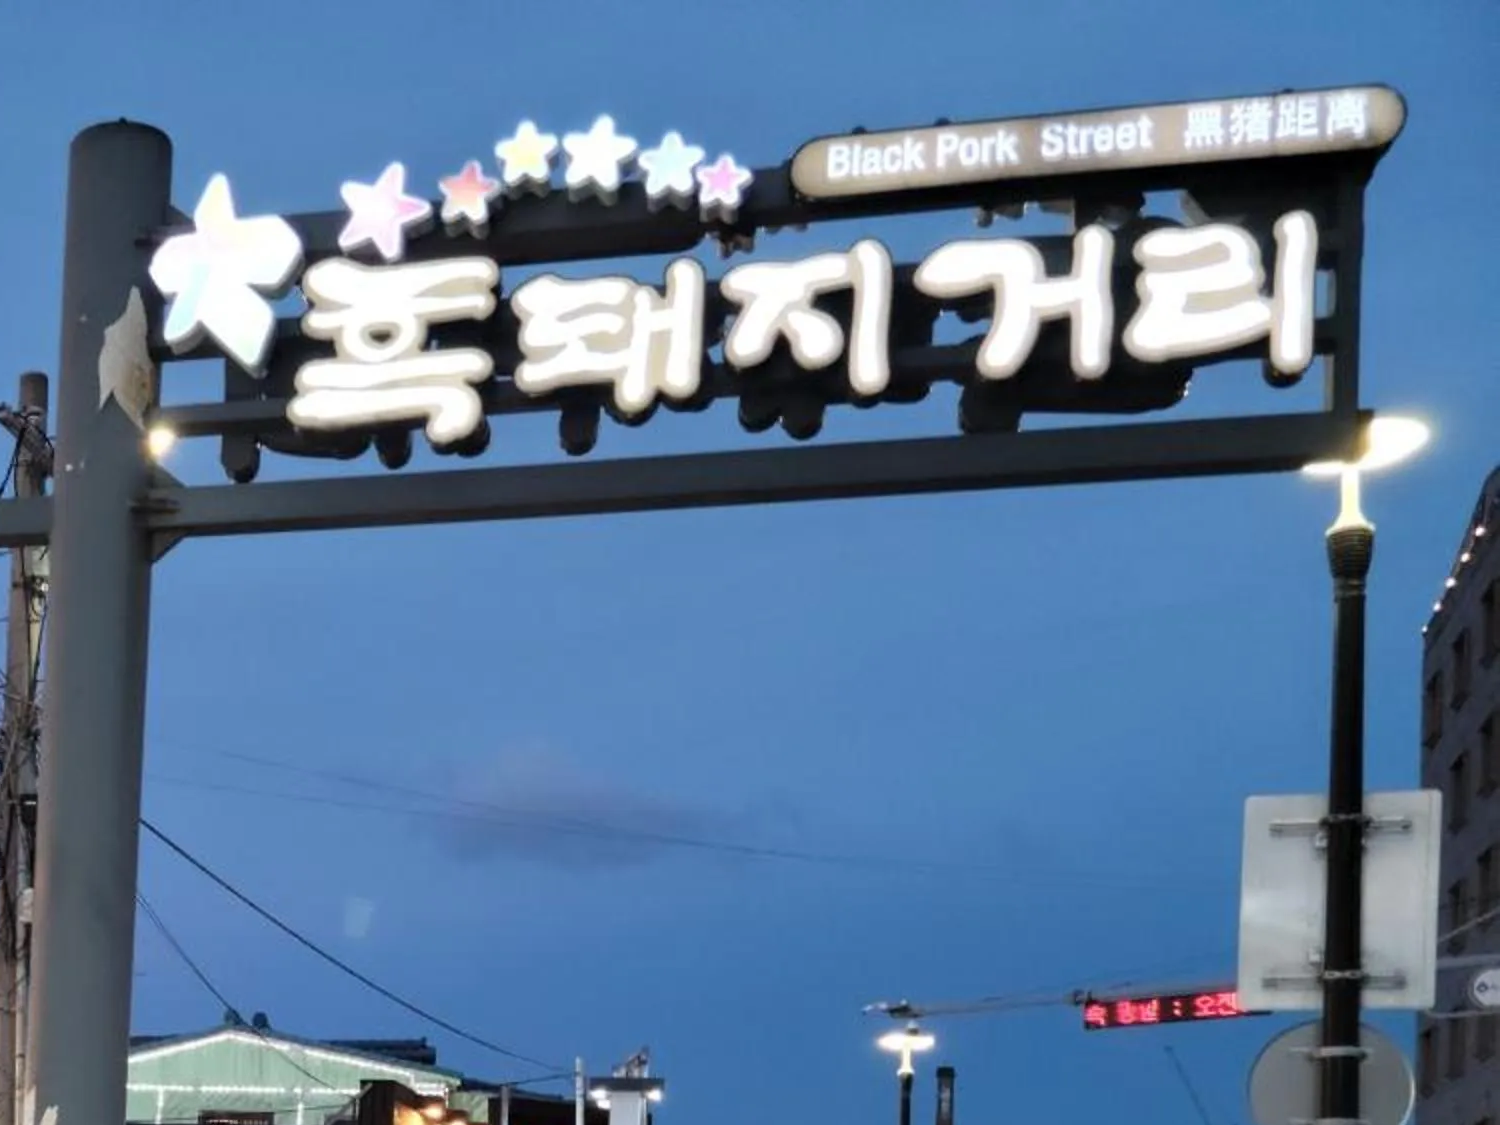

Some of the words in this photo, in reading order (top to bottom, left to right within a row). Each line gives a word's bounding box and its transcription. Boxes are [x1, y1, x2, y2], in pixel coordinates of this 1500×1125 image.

[826, 136, 927, 179] Black
[936, 129, 1020, 168] Pork
[1040, 114, 1154, 159] Street
[288, 210, 1317, 446] 흑돼지거리
